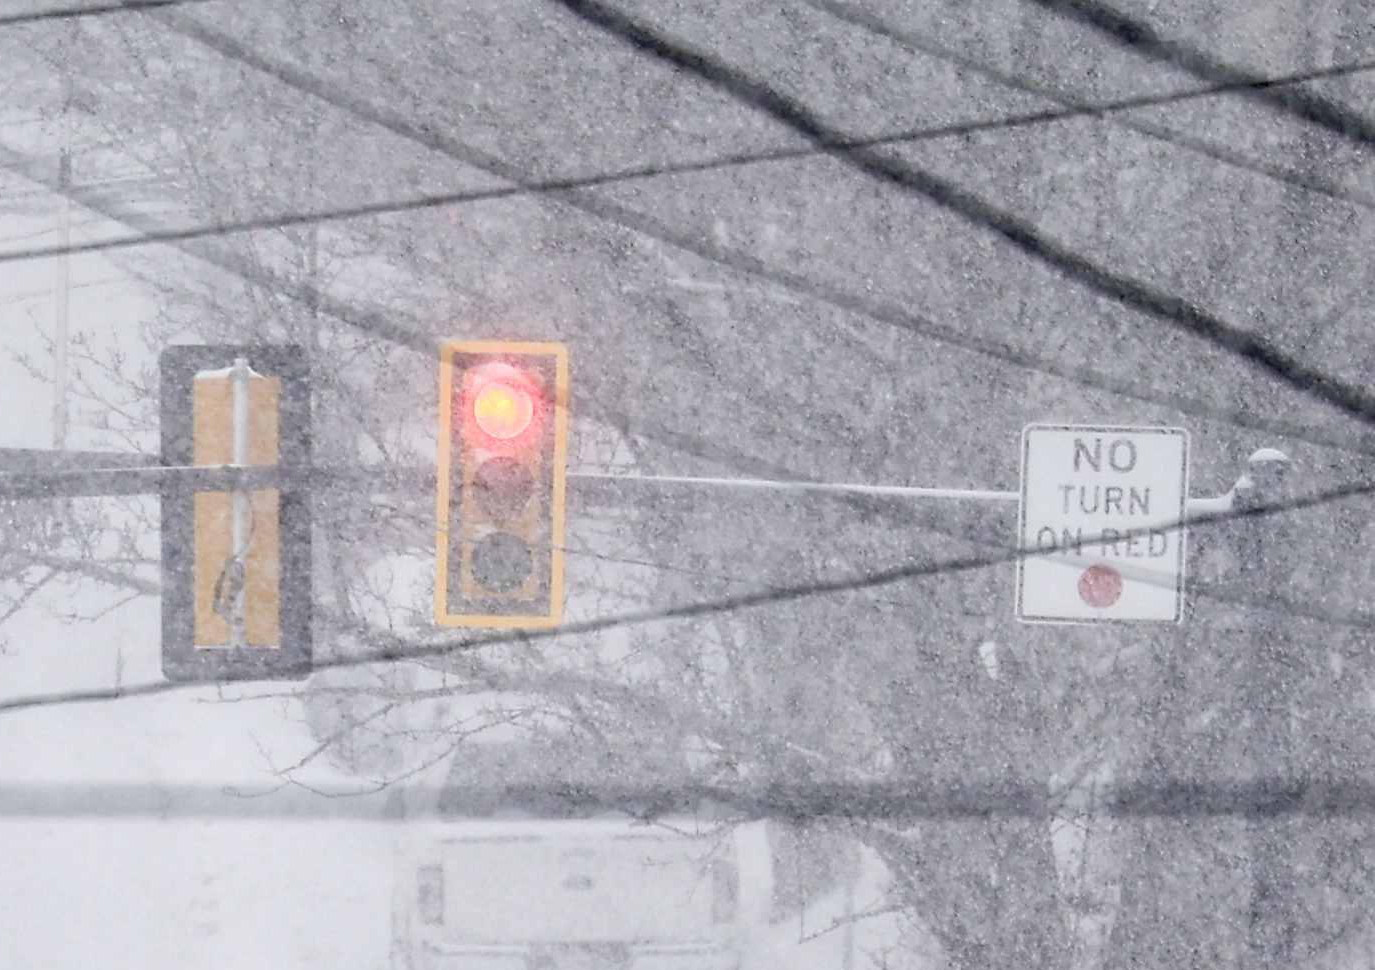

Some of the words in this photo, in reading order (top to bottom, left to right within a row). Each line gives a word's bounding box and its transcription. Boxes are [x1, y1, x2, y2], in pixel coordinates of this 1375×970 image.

[1072, 438, 1137, 473] NO
[1059, 485, 1151, 515] TURN
[1036, 526, 1082, 556] ON
[1100, 528, 1167, 558] RED
